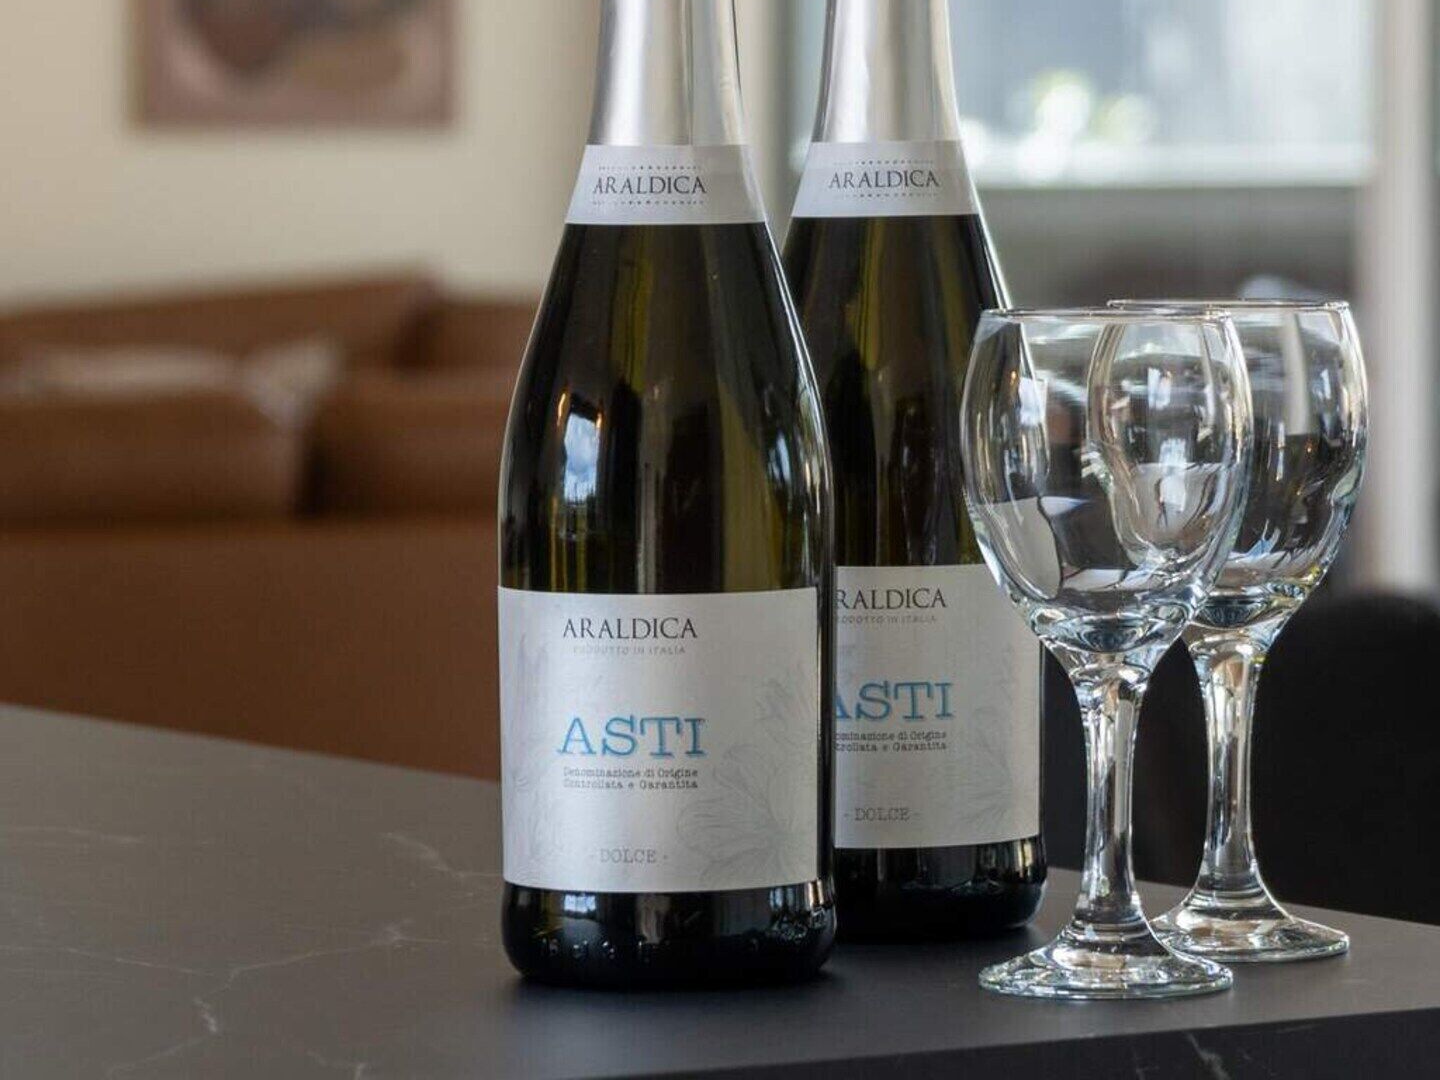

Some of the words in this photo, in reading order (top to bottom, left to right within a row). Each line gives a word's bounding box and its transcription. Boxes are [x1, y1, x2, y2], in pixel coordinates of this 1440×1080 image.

[593, 176, 707, 194] ARALDICA
[828, 170, 941, 188] ARALDICA
[834, 588, 947, 609] RALDICA
[563, 617, 698, 639] ARALDICA
[557, 714, 708, 759] ASTI
